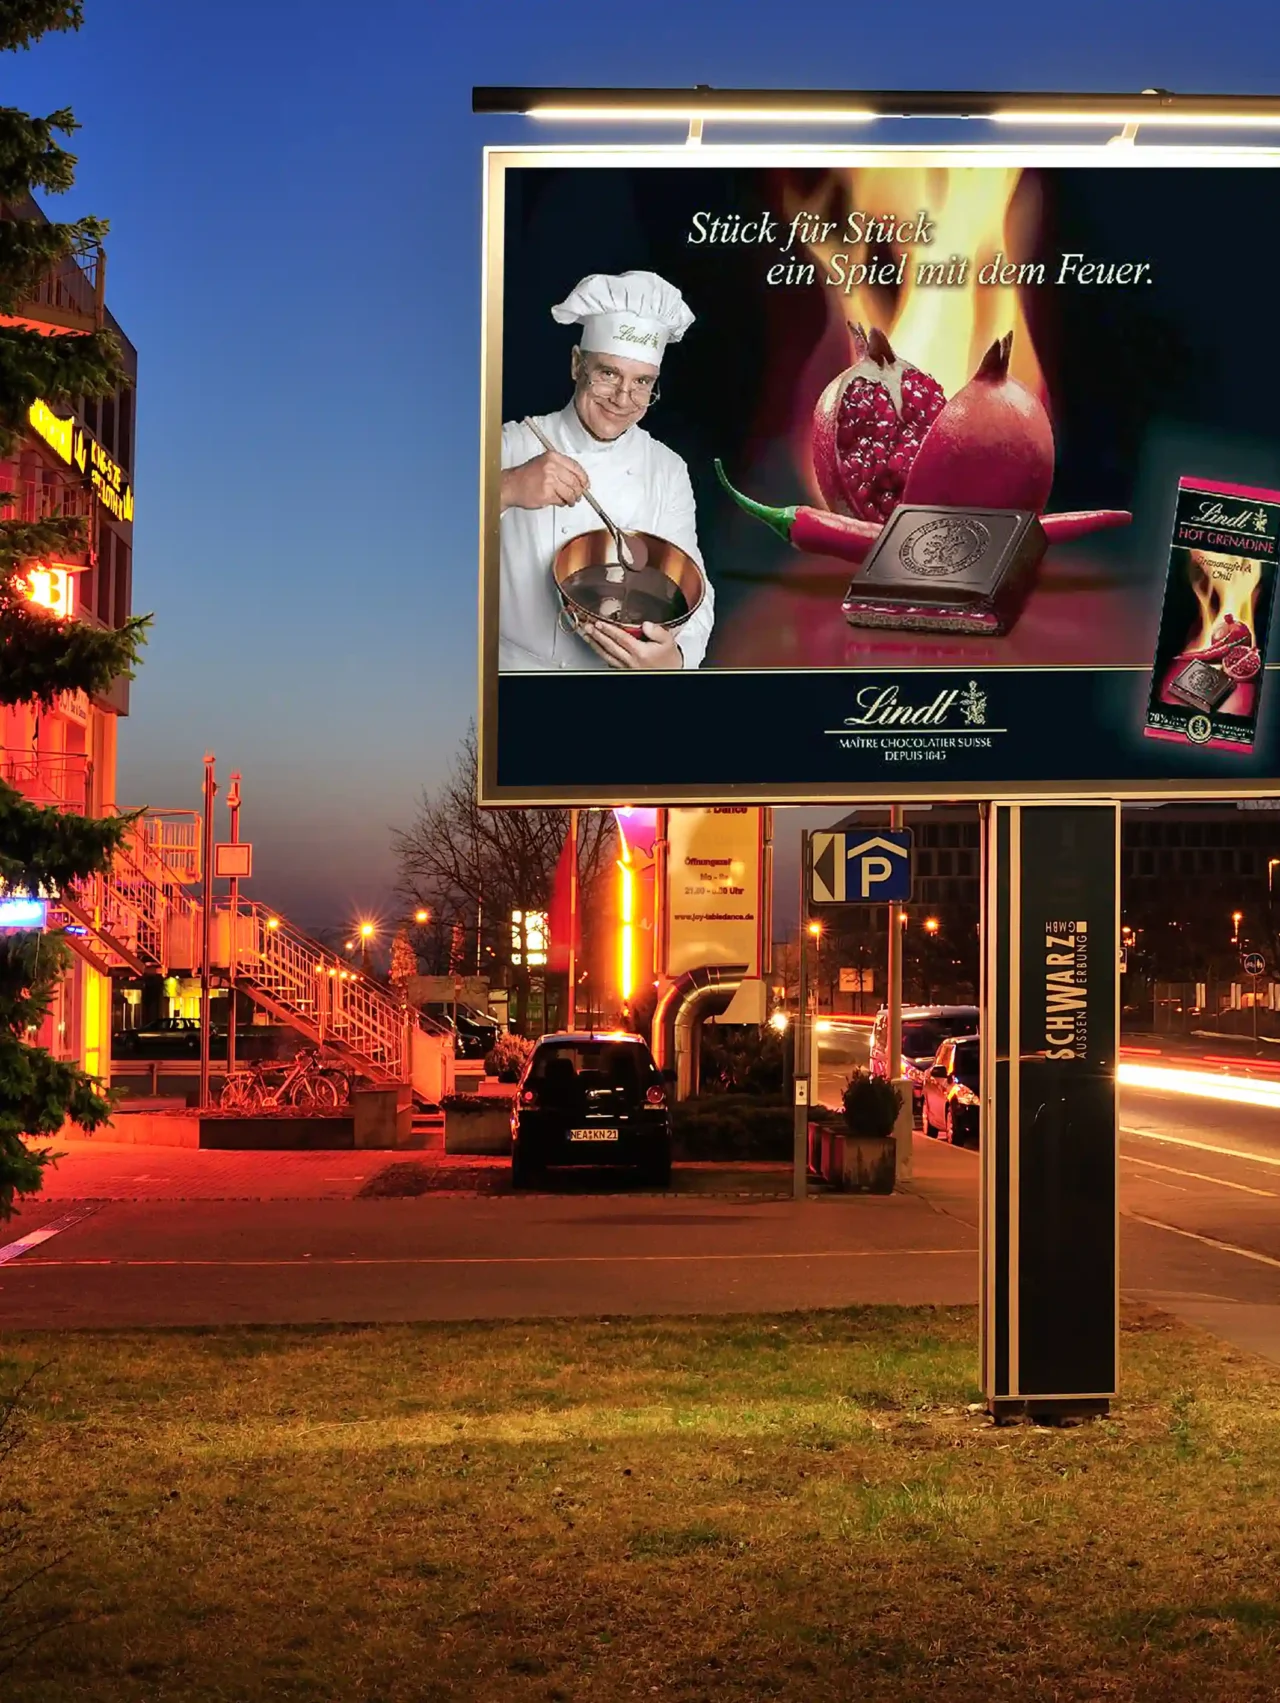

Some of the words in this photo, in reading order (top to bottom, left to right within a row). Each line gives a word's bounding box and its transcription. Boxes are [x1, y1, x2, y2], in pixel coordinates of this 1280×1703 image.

[688, 211, 778, 244] Stück
[782, 211, 837, 252] für
[843, 211, 934, 244] Stück
[767, 259, 815, 285] ein
[826, 254, 907, 293] Spiel
[916, 258, 969, 286] mit
[979, 254, 1045, 285] dem
[1055, 254, 1154, 285] Feuer.
[1190, 501, 1253, 529] Lindt
[1179, 526, 1205, 541] HOT
[1207, 532, 1275, 554] GRENADINE
[844, 686, 960, 725] Lindt
[839, 736, 879, 748] MAÎTRE
[881, 738, 956, 748] CHOCOLATIER
[958, 737, 992, 748] SUISSE
[885, 751, 923, 761] DEPUIS
[861, 856, 893, 898] P
[1045, 935, 1088, 1061] SCHWARZ
